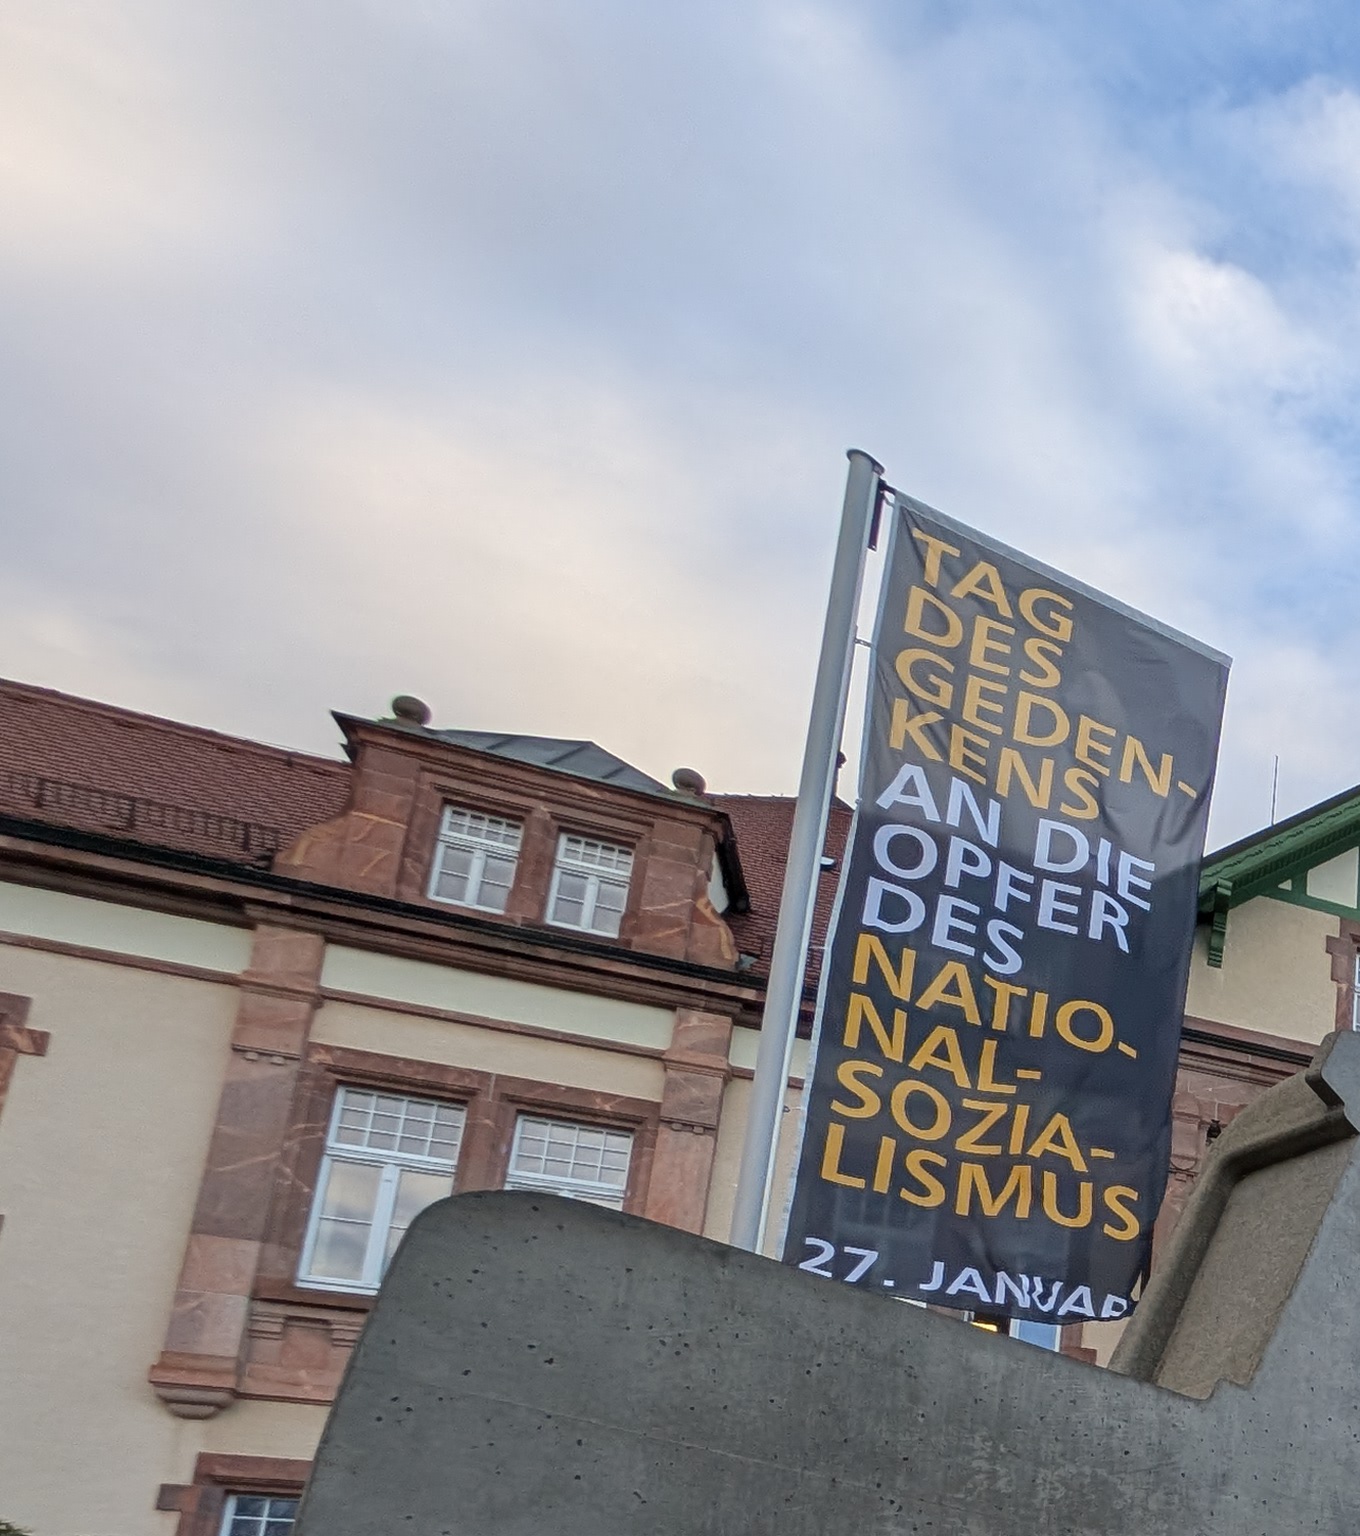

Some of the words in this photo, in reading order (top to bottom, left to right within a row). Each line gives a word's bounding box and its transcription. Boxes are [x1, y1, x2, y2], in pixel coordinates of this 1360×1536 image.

[904, 585, 1063, 688] DES
[911, 527, 1073, 642] TAG
[889, 698, 1100, 820] KENS
[895, 648, 1197, 799] GEDEN-
[873, 823, 1130, 954] OPFER
[876, 763, 1001, 848] AN
[1033, 818, 1155, 911] DIE
[862, 876, 1025, 975] DES
[843, 992, 1042, 1095] NAL-
[852, 933, 1138, 1059] NATIO-
[830, 1059, 1116, 1173] SOZIA-
[820, 1122, 1141, 1242] LISMUS
[798, 1236, 895, 1287] 27.
